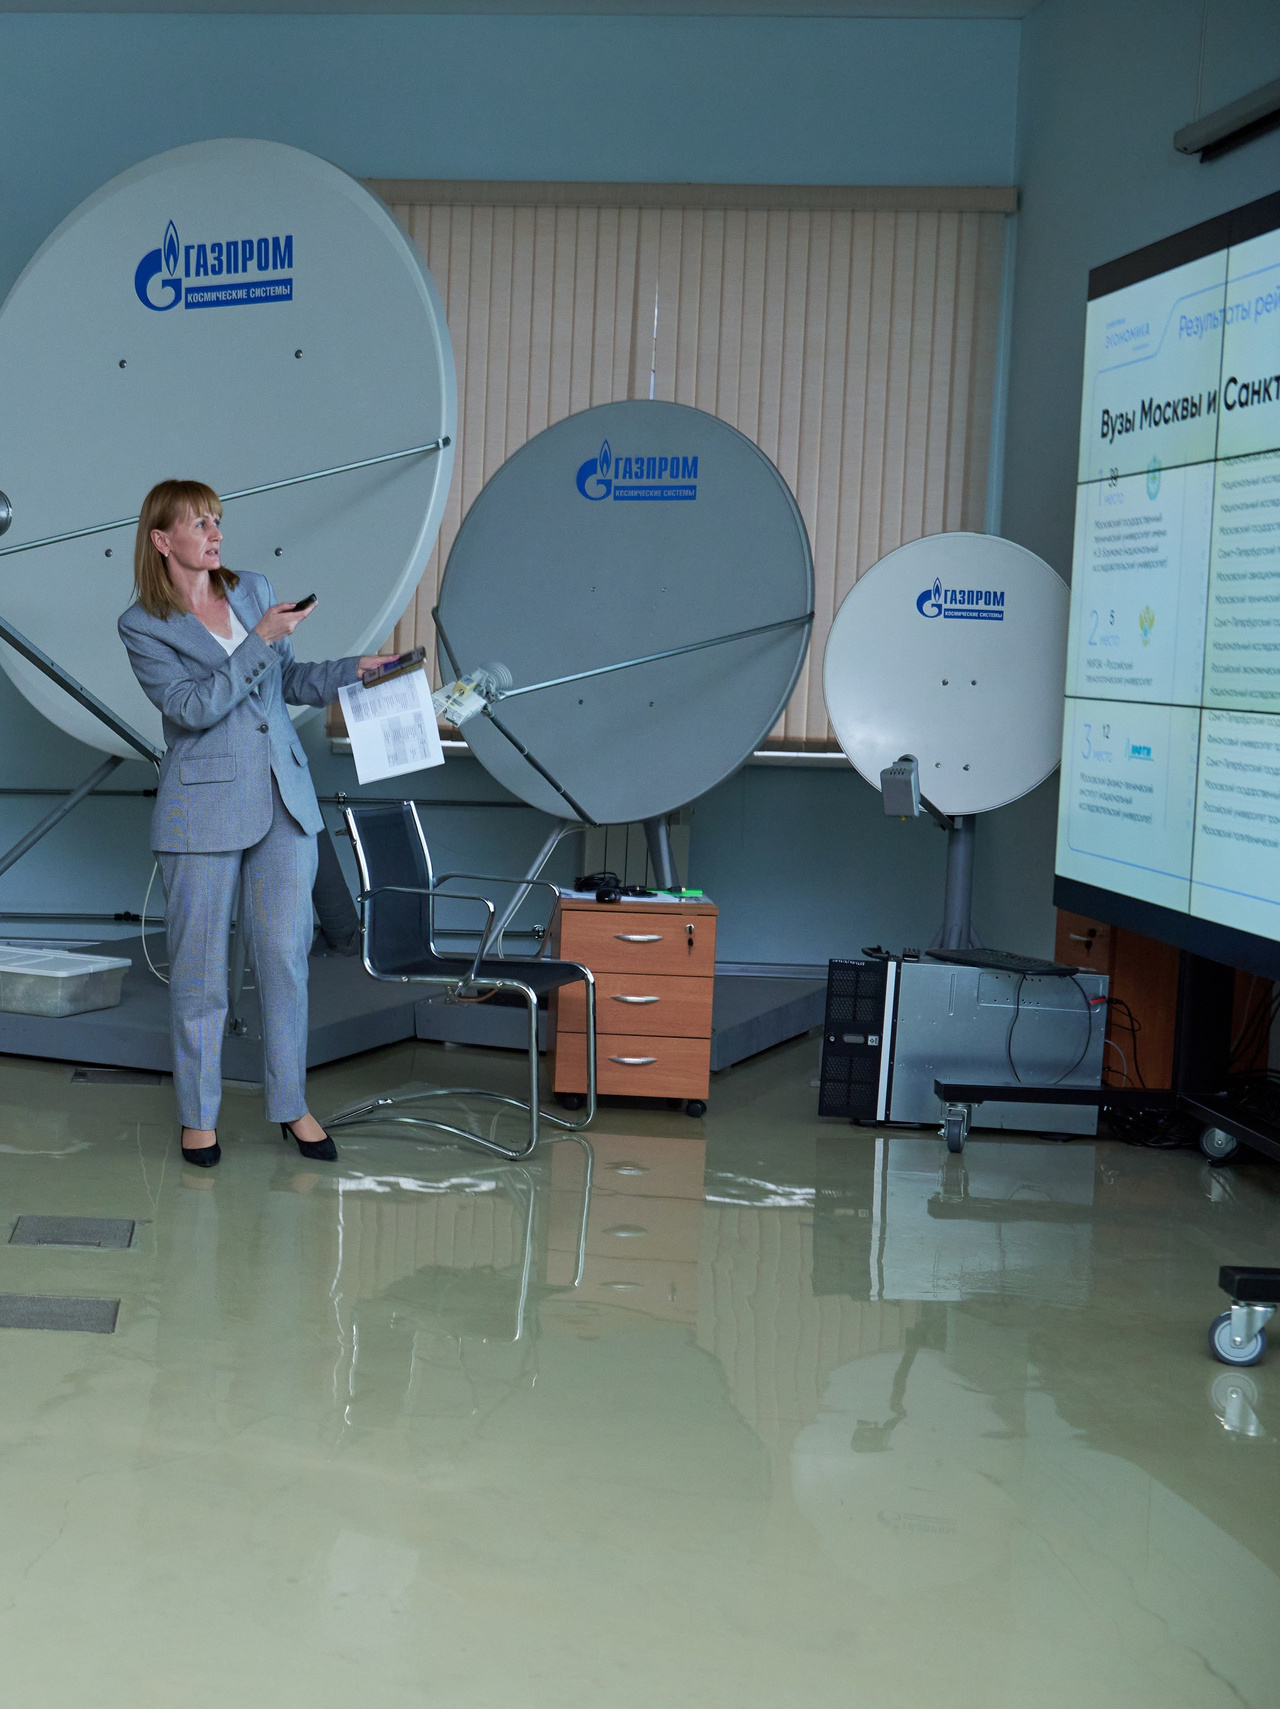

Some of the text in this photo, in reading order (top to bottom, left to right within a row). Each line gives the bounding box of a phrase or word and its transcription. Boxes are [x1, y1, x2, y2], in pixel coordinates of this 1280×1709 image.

[184, 235, 293, 278] ГАЗПРОМ
[187, 284, 291, 303] КОСМИЧЕСКИЕ СИСТЕМЫ
[1101, 408, 1136, 445] Вузы
[1139, 391, 1203, 431] Москвы
[1207, 389, 1218, 415] и
[614, 456, 699, 480] ГАЗПРОМ
[615, 489, 695, 497] КОСМИЧЕСКИЕ СИСТЕМЫ
[944, 589, 1005, 607] ГАЗПРОМ
[945, 610, 978, 618] КОСМИЧЕСКИЕ
[1088, 609, 1098, 646] 2
[1081, 723, 1091, 760] 3
